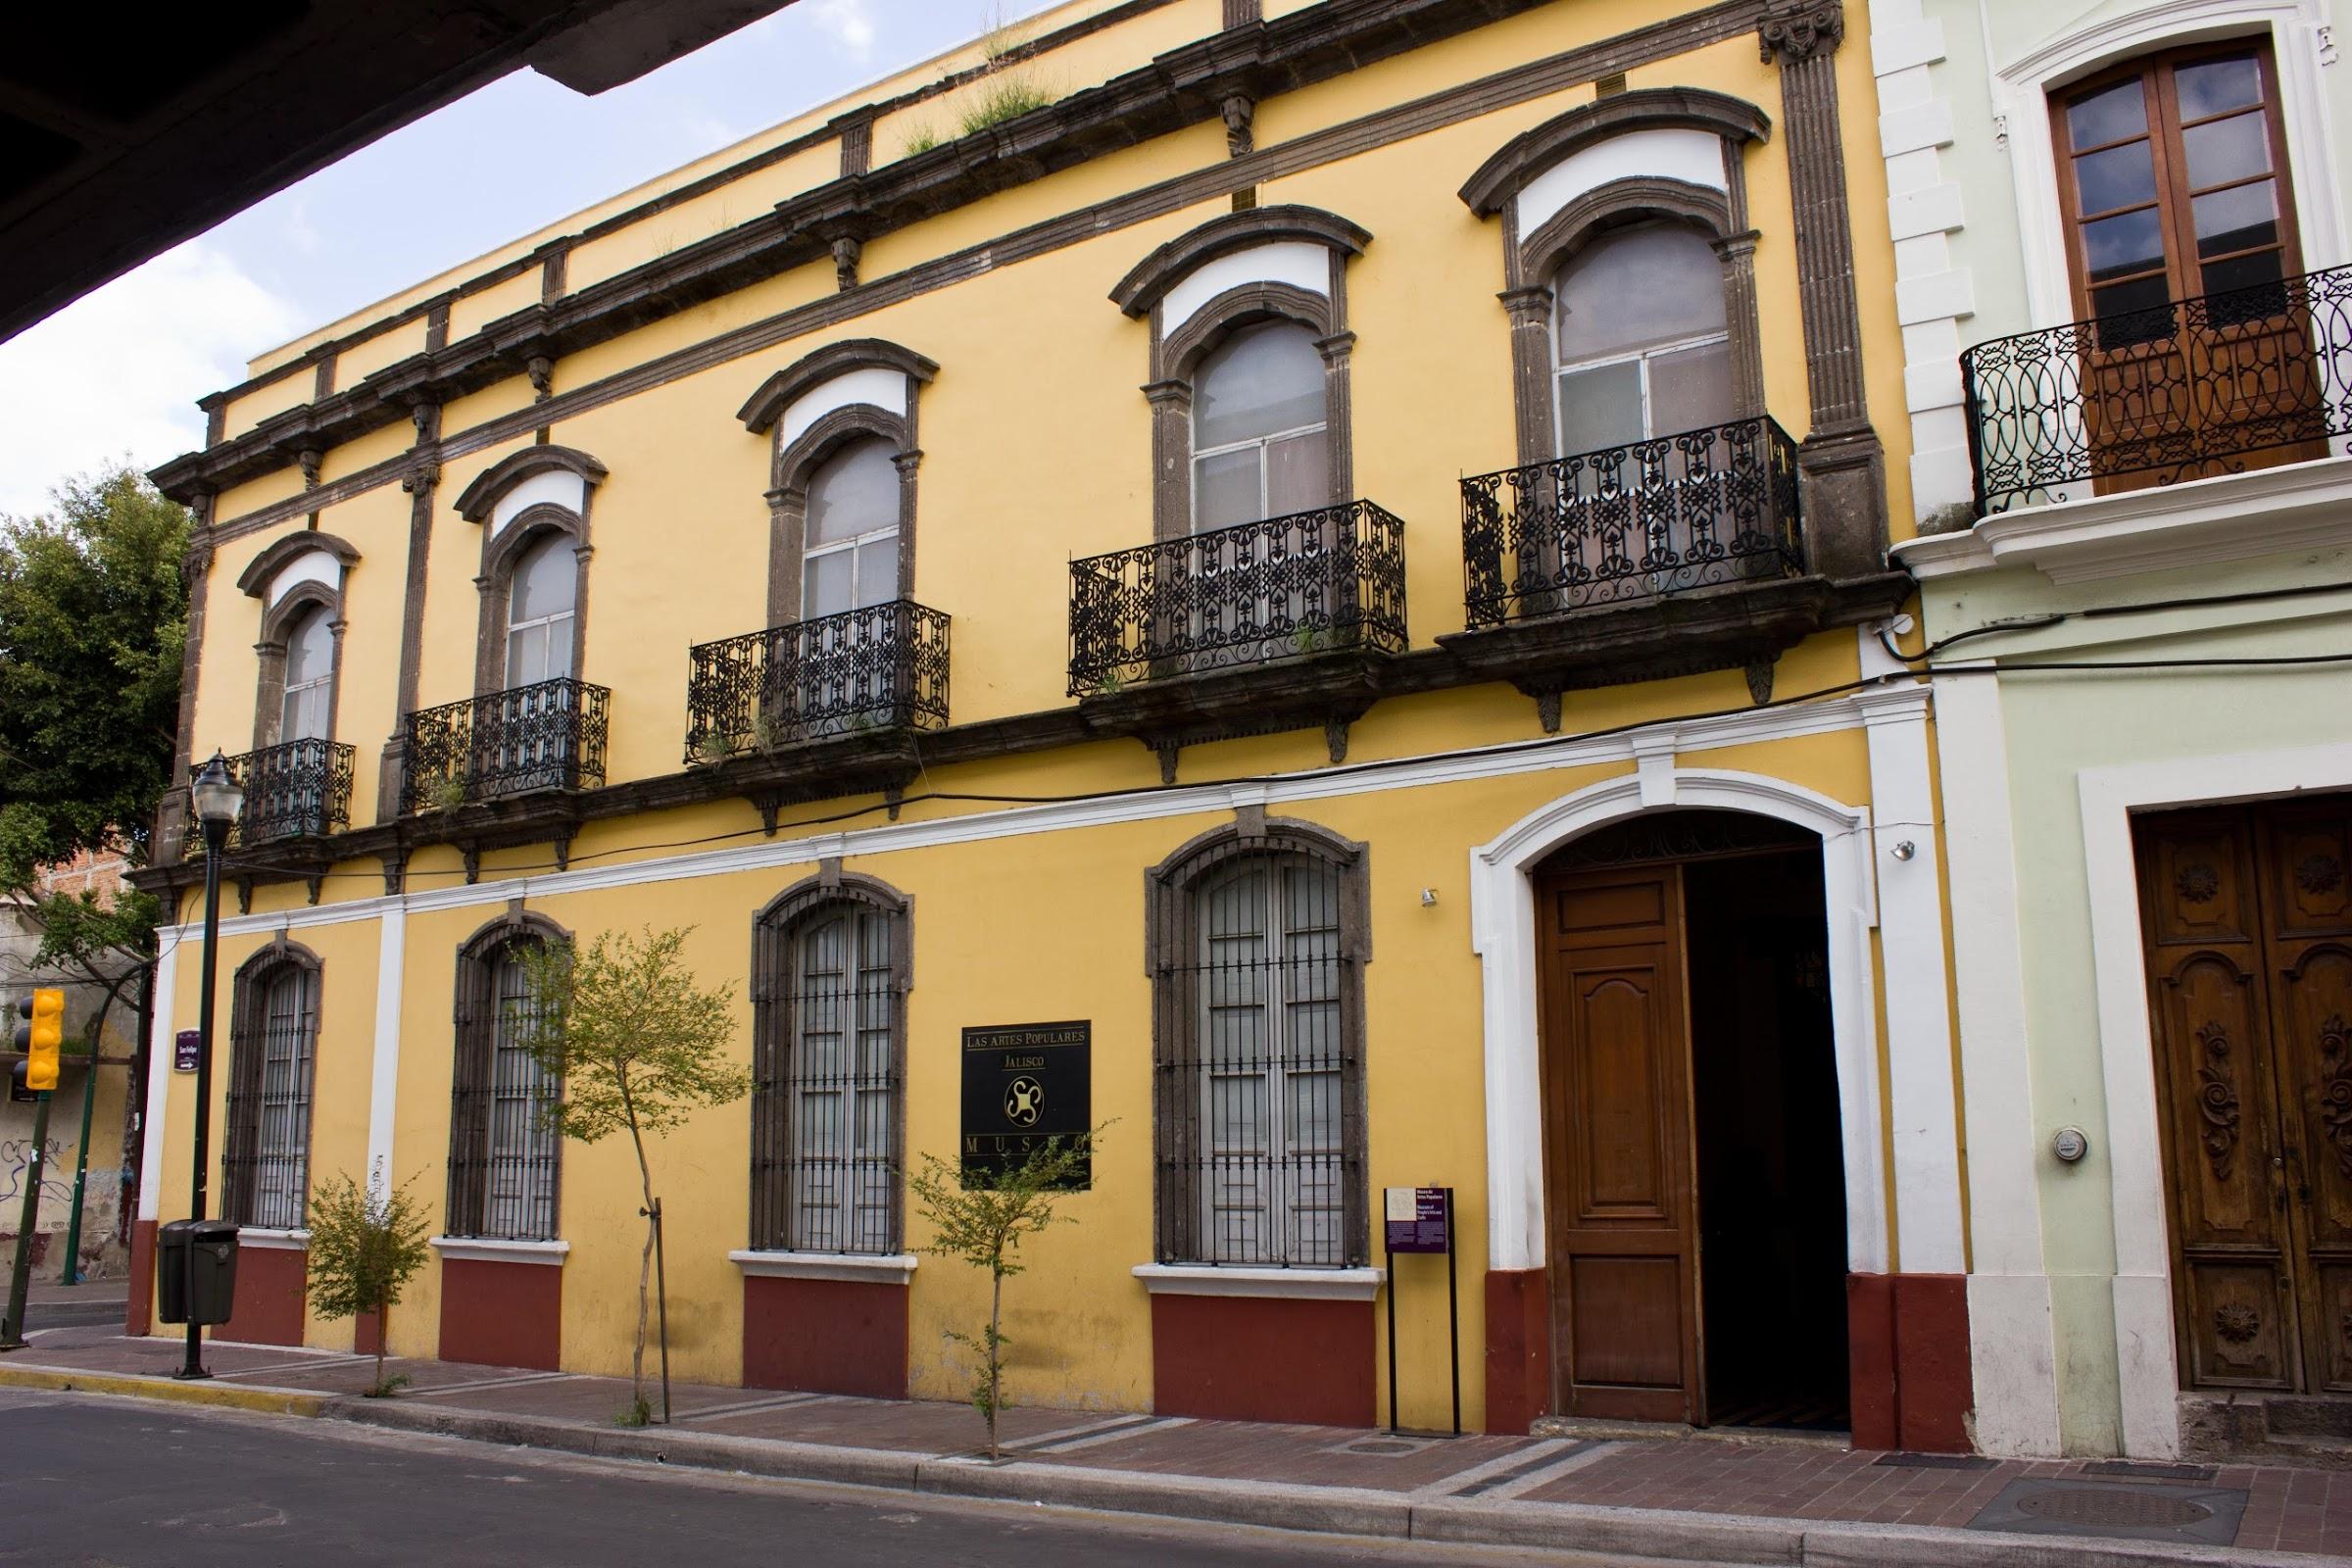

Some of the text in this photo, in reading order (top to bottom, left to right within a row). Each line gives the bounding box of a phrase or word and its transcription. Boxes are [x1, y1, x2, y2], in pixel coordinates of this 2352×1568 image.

[967, 1031, 1085, 1048] LAS ARTES POPULARES
[1004, 1054, 1045, 1068] JALISCO
[966, 1136, 1085, 1153] MUSO
